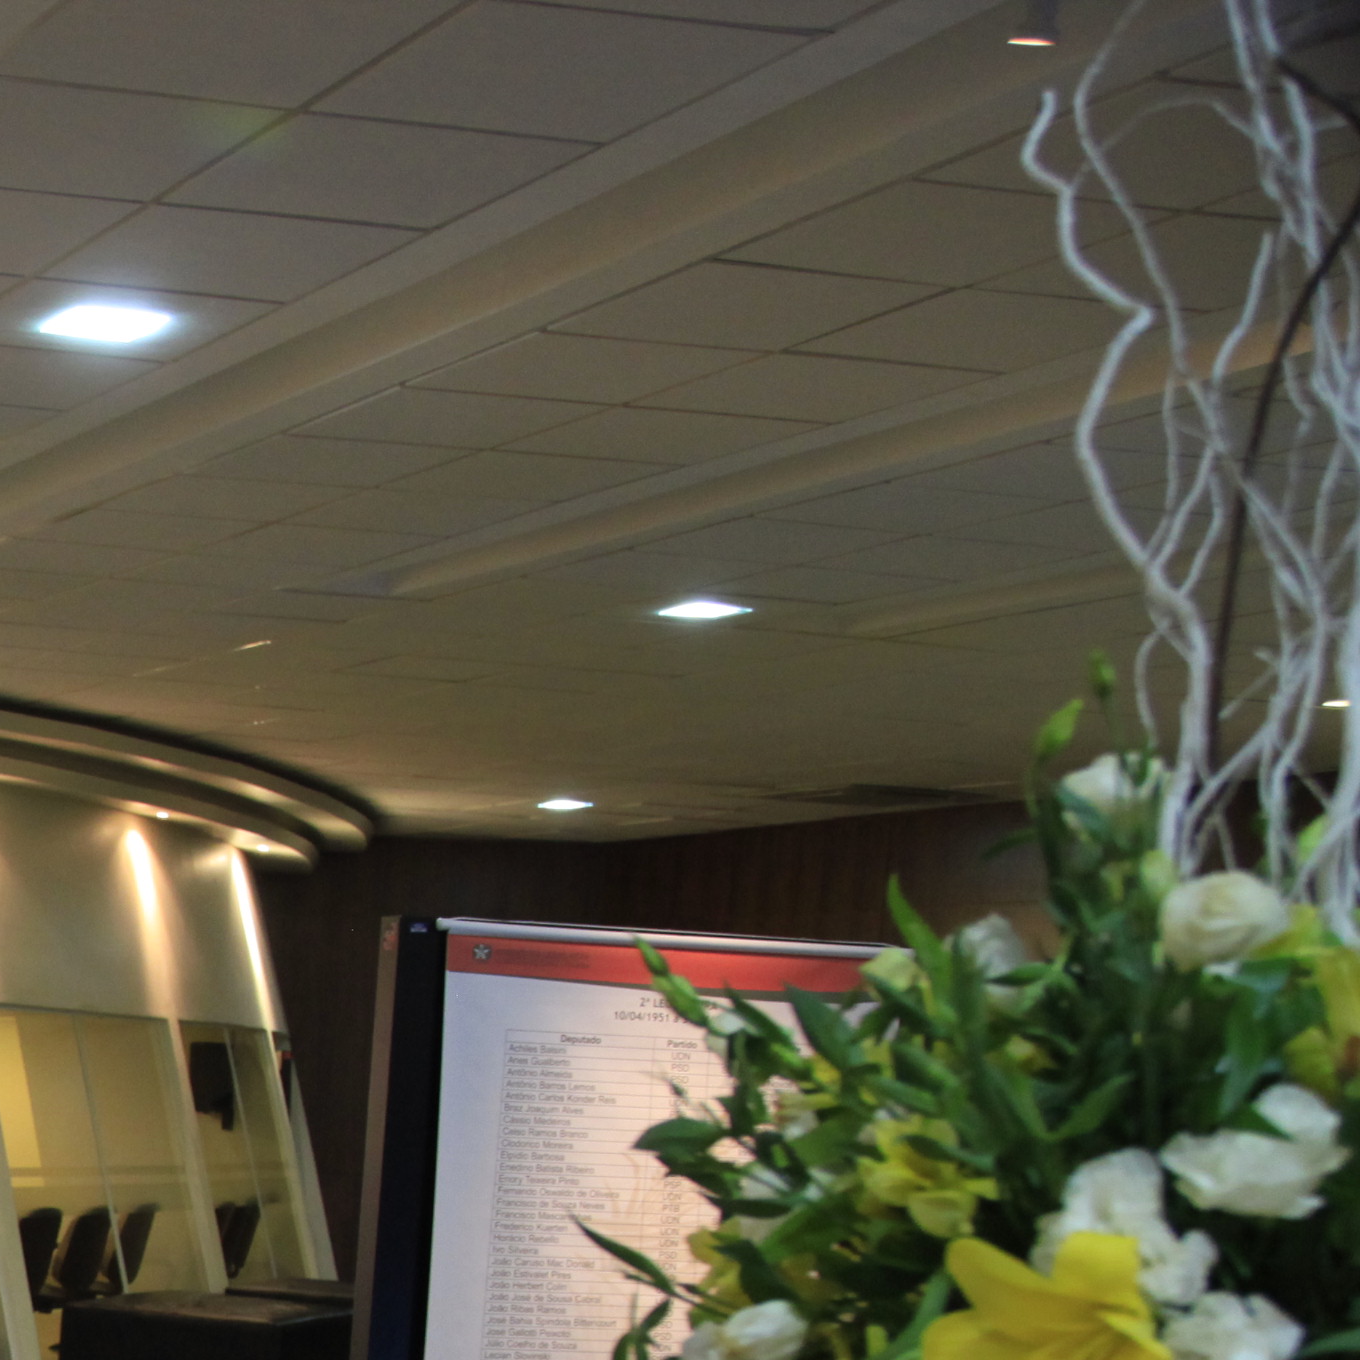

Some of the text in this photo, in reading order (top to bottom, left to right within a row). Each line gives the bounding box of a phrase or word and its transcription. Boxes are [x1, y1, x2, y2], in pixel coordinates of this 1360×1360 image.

[614, 1011, 669, 1022] 10/04/1951
[559, 1034, 602, 1045] Deputado
[665, 1039, 697, 1048] Partido
[670, 1051, 691, 1059] UDN
[505, 1067, 572, 1078] Antônio Almeida
[504, 1091, 536, 1100] Antônio
[536, 1092, 564, 1101] Carlos
[503, 1103, 583, 1114] Braz Joaquim Alves
[501, 1126, 587, 1137] Celso Ramos Branco
[492, 1245, 537, 1254] Ivo Silveira
